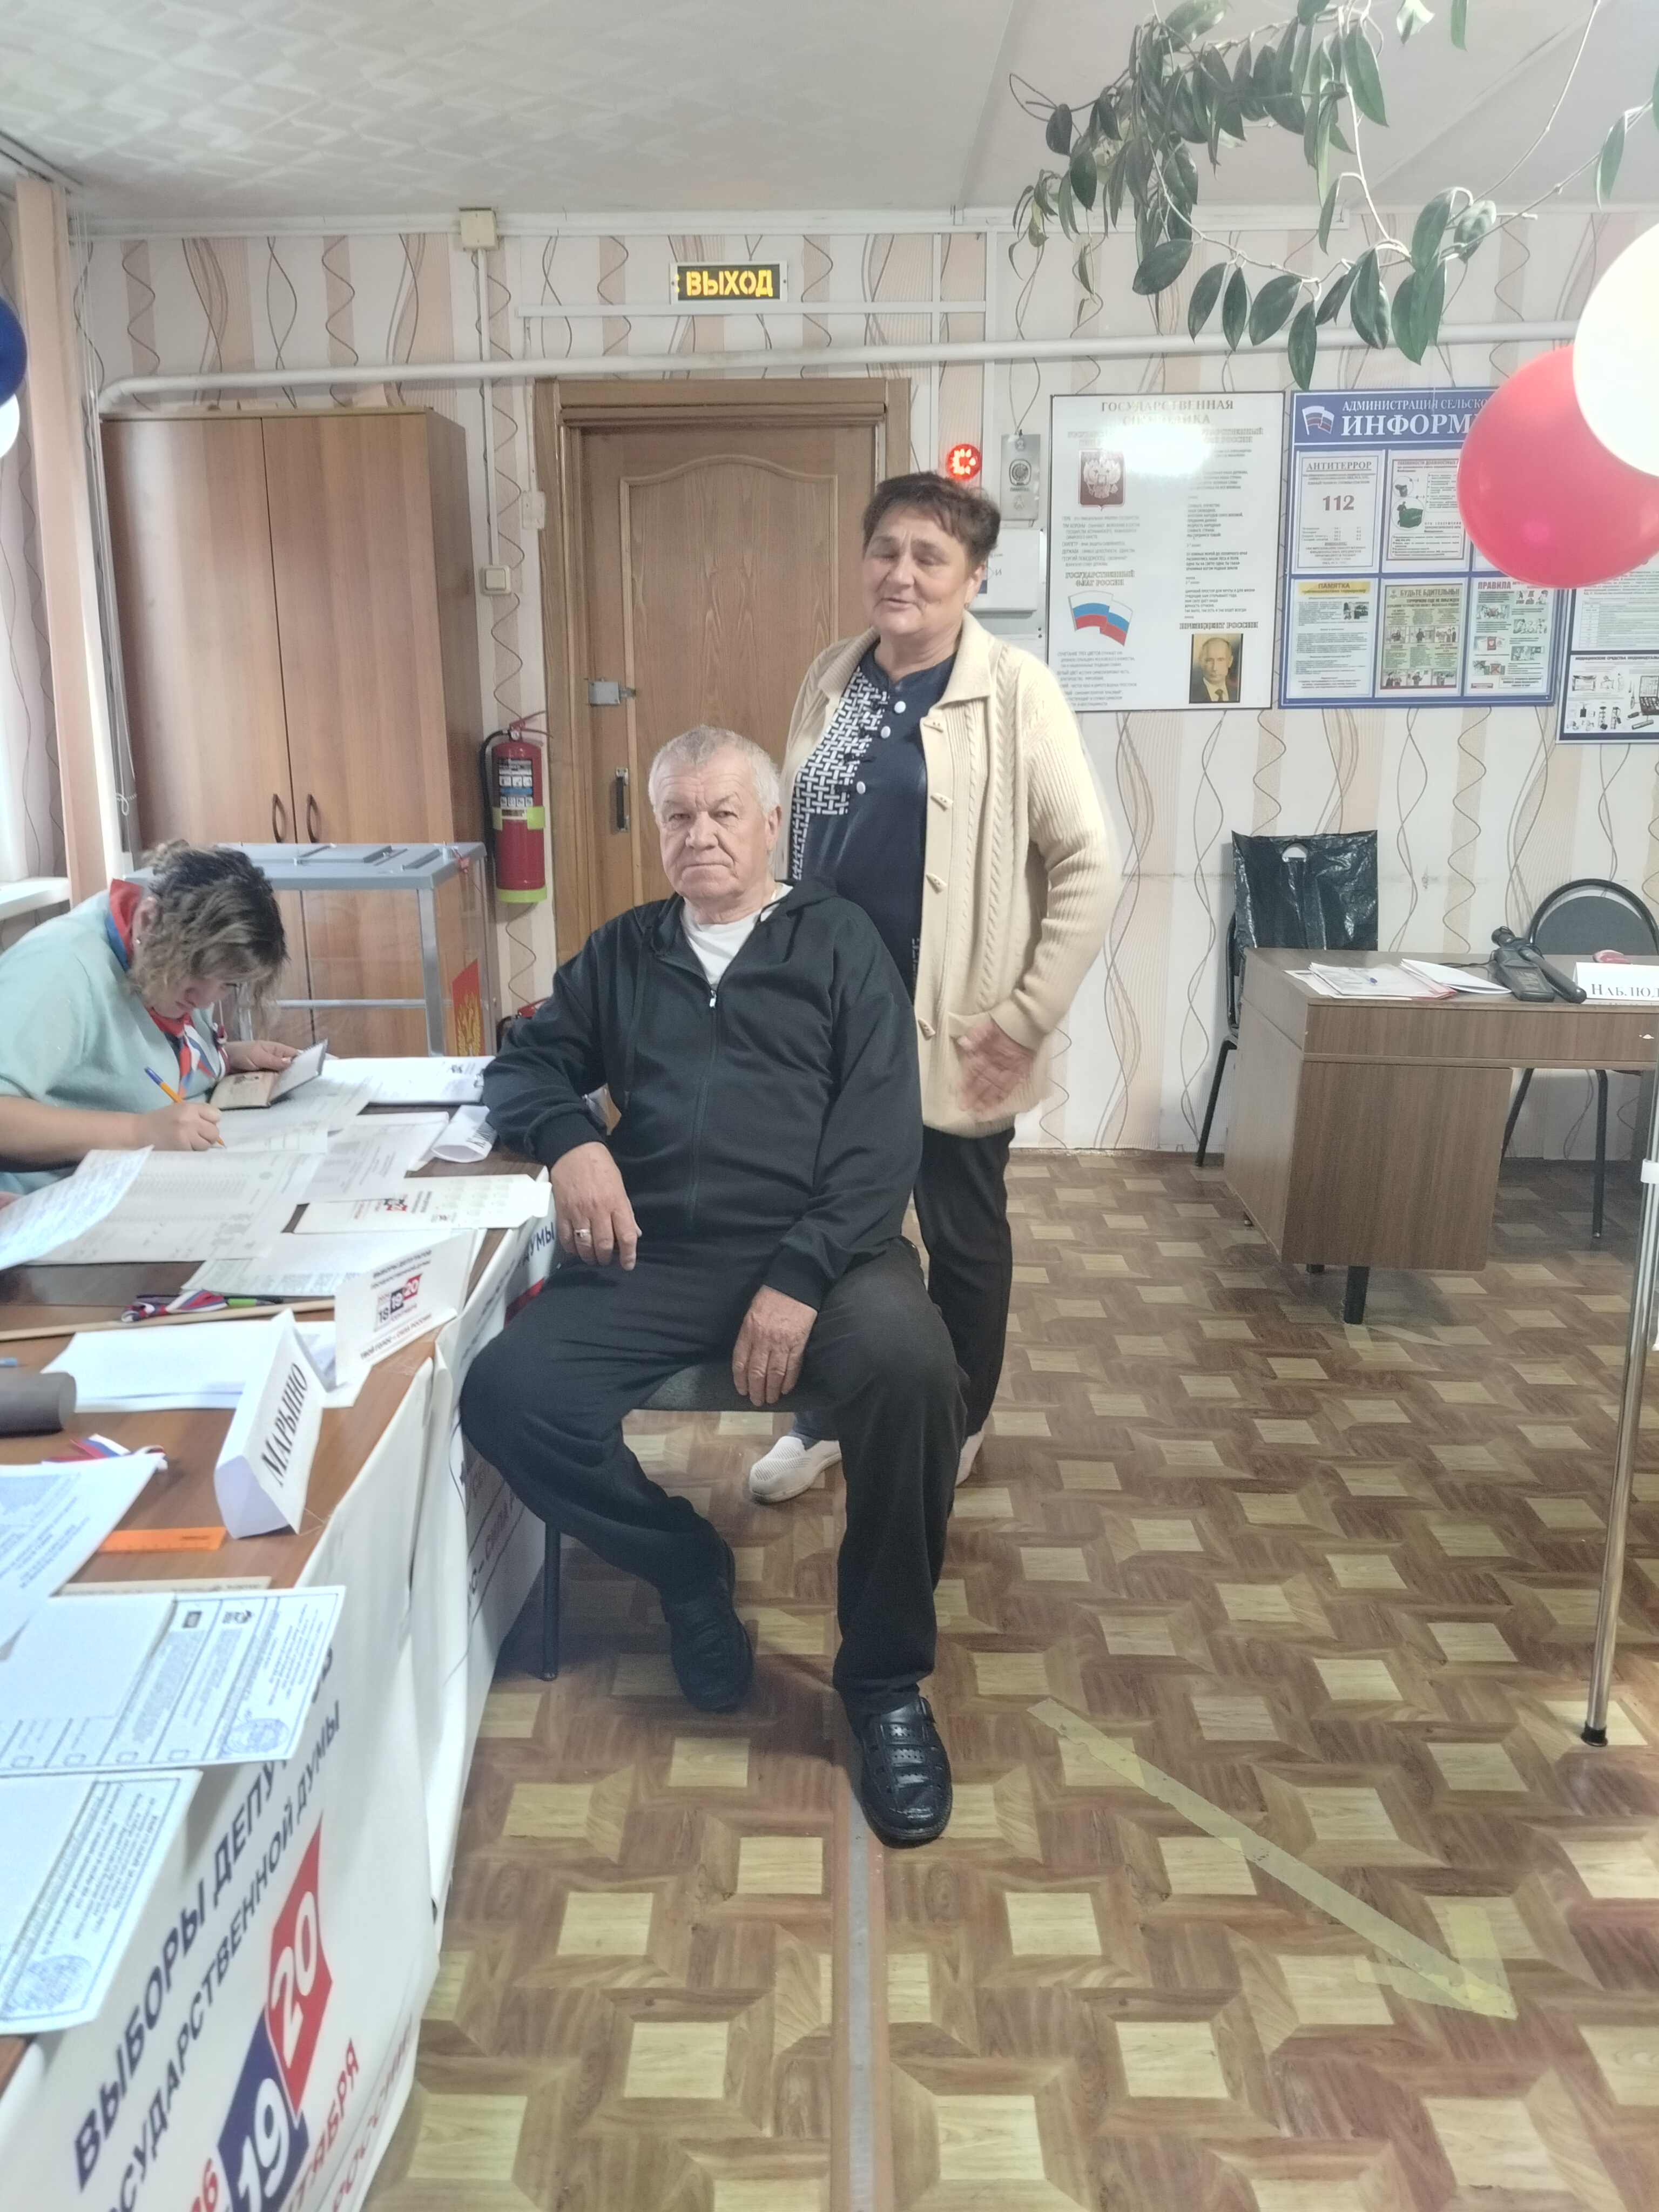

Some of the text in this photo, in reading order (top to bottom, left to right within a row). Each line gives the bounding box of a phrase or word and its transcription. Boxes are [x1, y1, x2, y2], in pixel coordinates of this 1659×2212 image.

[686, 269, 773, 296] ВЫХОД
[1102, 400, 1233, 412] ГОСУДАРСТВЕННАЯ
[1343, 400, 1438, 412] АДМИНИСТРАЦИЯ
[1340, 414, 1478, 436] ИНФОРМ
[1307, 461, 1371, 470] АНТИТЕРРОР
[1323, 495, 1354, 511] 112
[379, 1279, 419, 1323] 18 19 20
[261, 1362, 308, 1489] МАРЬИНО
[110, 1796, 293, 2212] СУДАРСТВЕННОЙ
[298, 1700, 340, 1825] ДУМЫ
[75, 1878, 206, 2193] ВЫБОРЫ
[238, 1891, 318, 2212] 19 20
